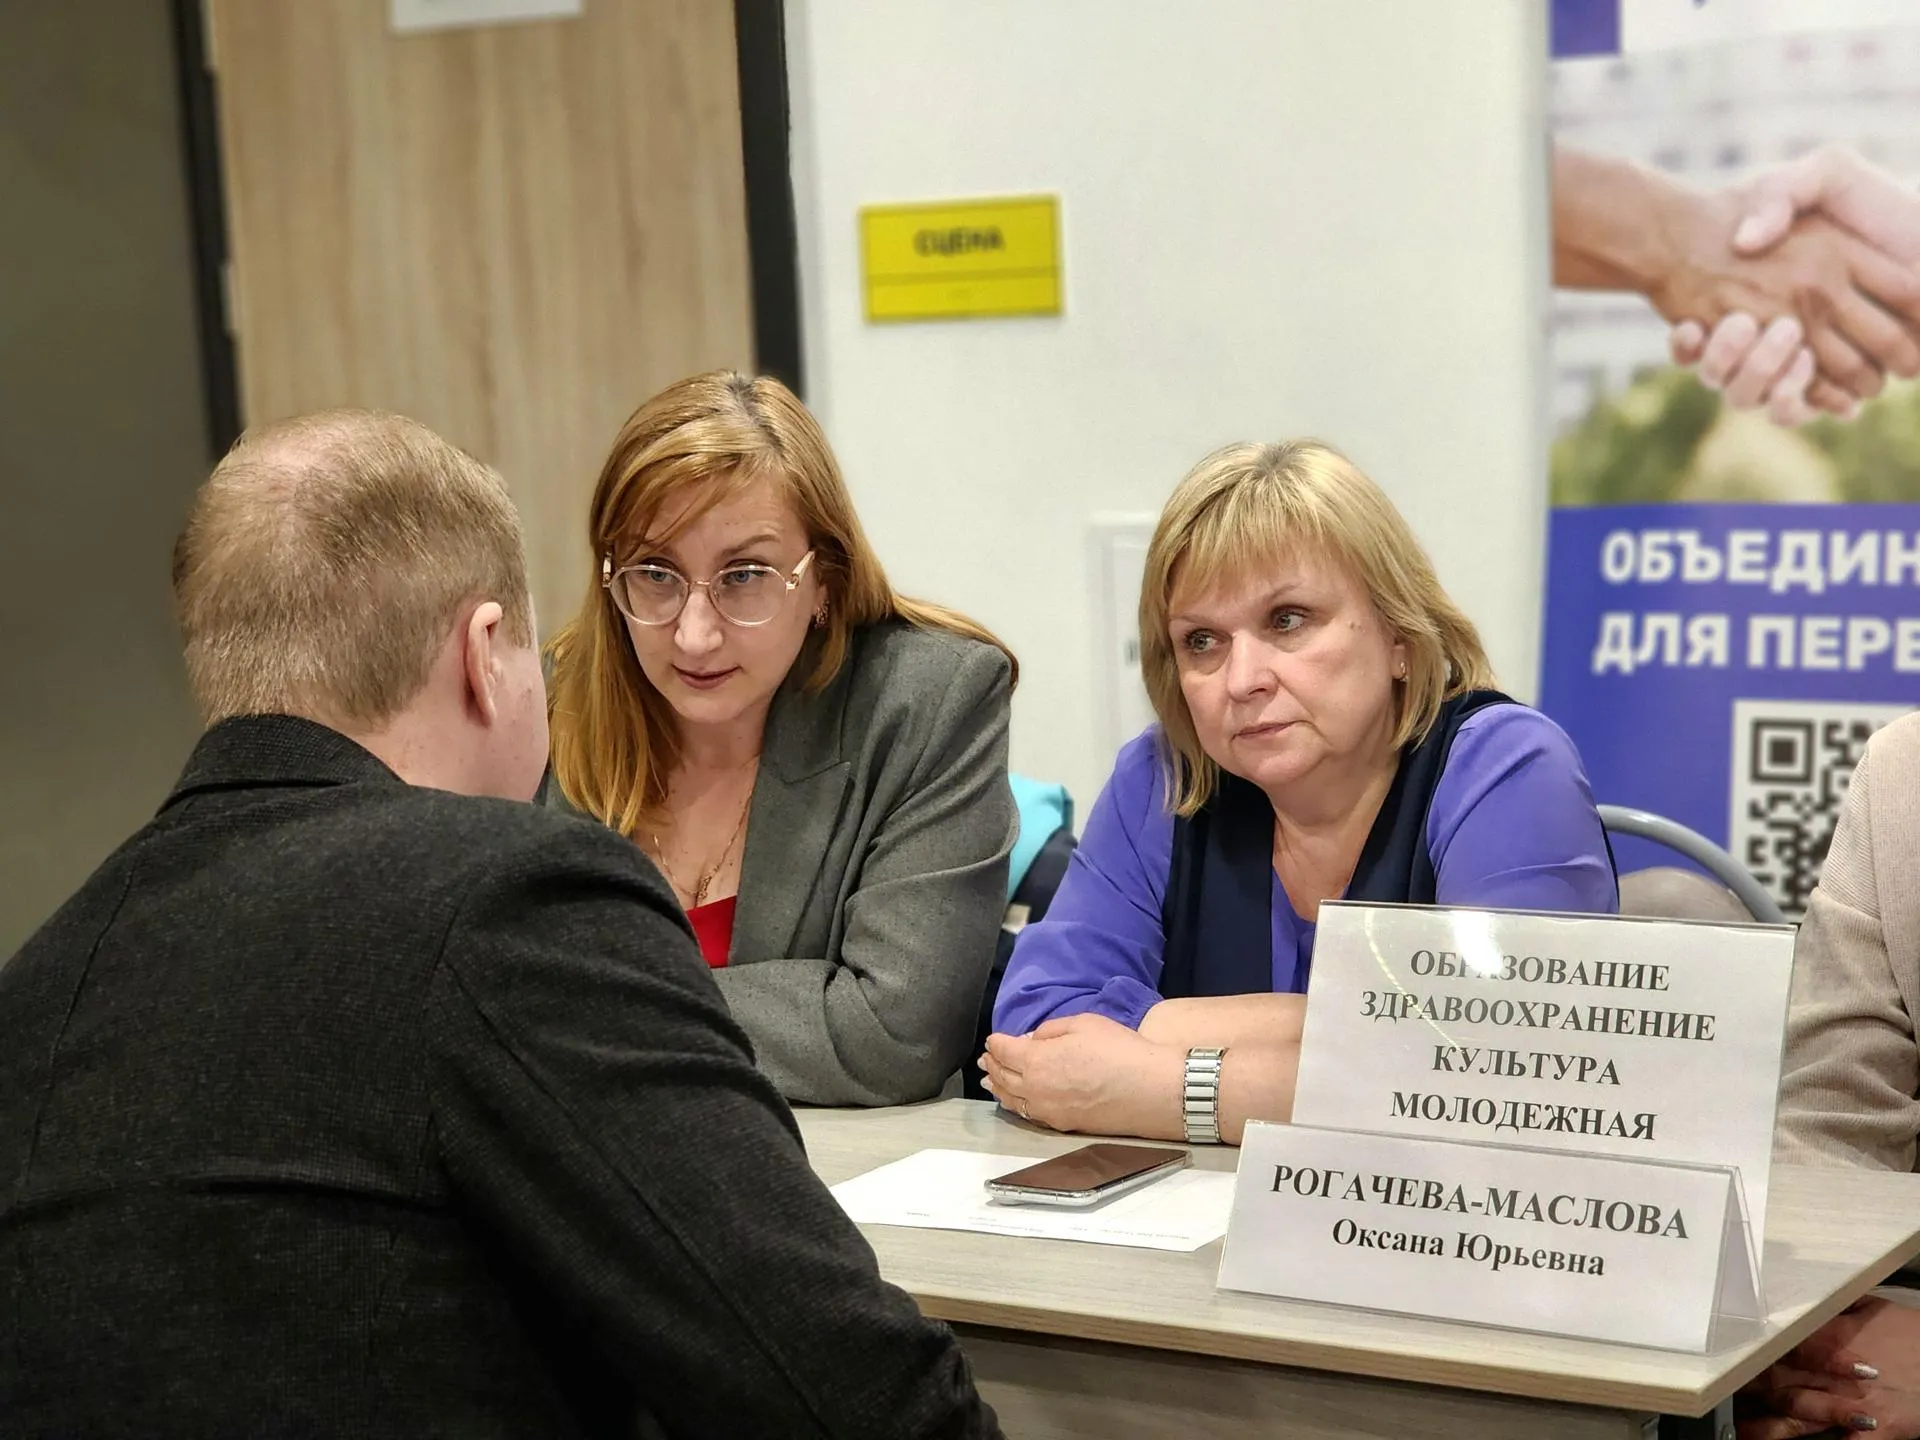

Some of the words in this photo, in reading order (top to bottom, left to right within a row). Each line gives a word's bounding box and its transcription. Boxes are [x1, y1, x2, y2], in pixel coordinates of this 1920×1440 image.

[1602, 530, 1920, 594] ОБЪЕДИН
[1591, 612, 1730, 676] ДЛЯ
[1747, 614, 1920, 673] ПЕРЕ
[1410, 949, 1671, 992] ОБЗОВАНИЕ
[1360, 990, 1717, 1042] ЗДРАВООХРАНЕНИЕ
[1432, 1045, 1621, 1086] КУЛЬТУРА
[1391, 1091, 1658, 1142] МОЛОДЕЖНАЯ
[1271, 1164, 1690, 1240] РОГАЧЕВА-МАСЛОВА
[1332, 1217, 1444, 1257] Оксана
[1455, 1231, 1605, 1277] Юрьевна
